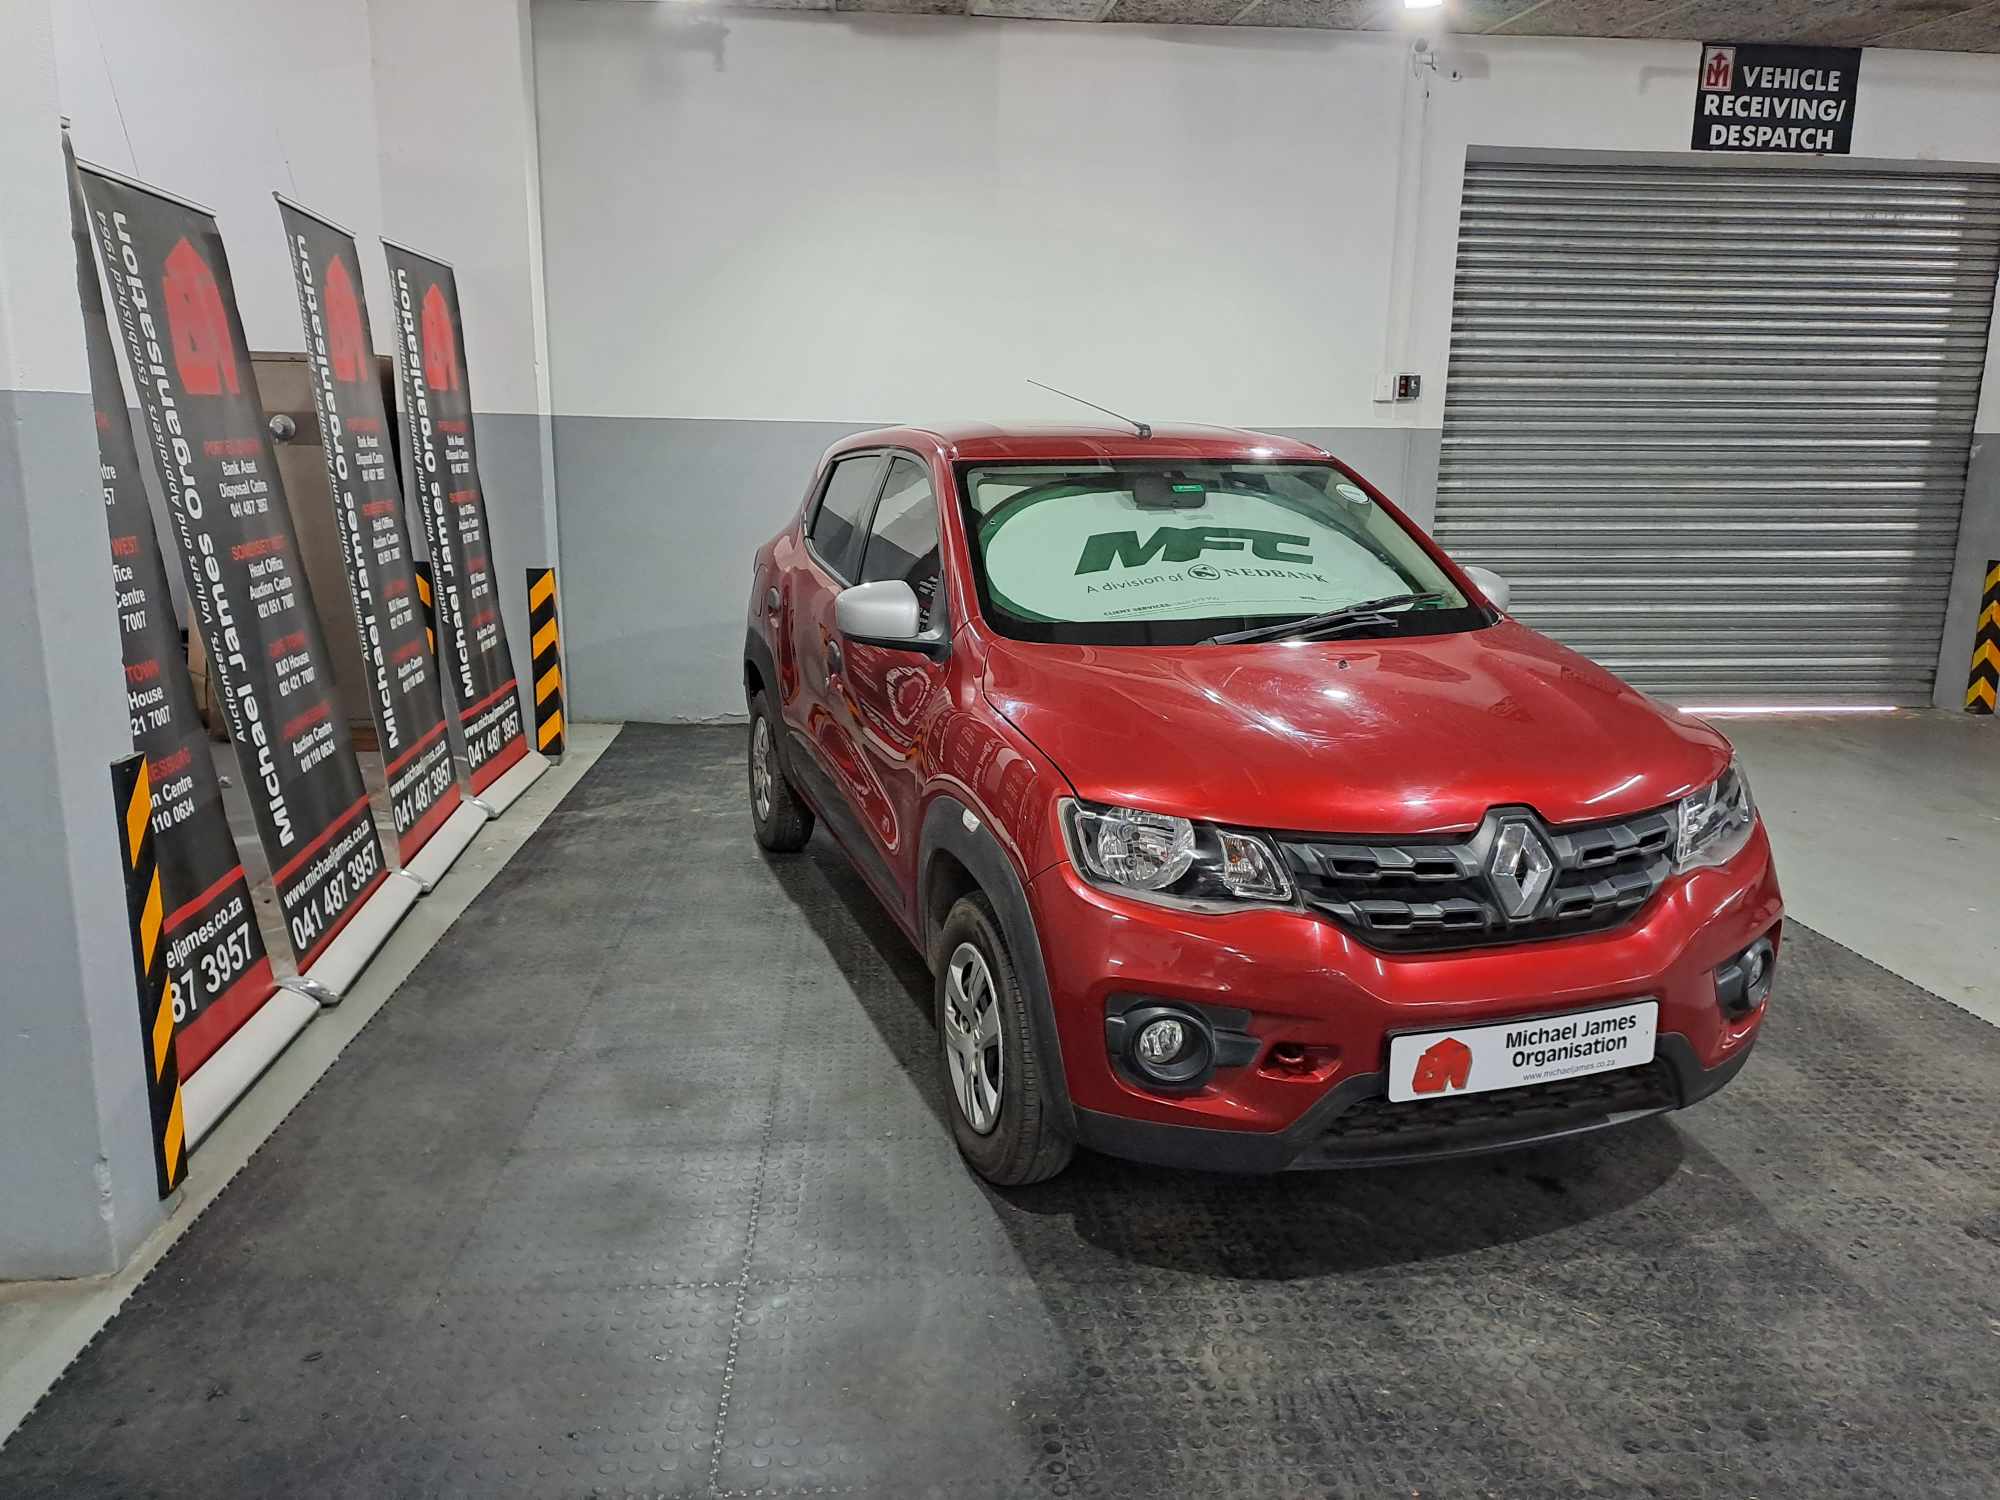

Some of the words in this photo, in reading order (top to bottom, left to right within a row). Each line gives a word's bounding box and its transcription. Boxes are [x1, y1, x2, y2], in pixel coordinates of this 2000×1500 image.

[1742, 66, 1841, 91] VEHICLE
[1703, 94, 1846, 122] RECEIVING/
[1709, 124, 1834, 150] DESPATCH
[96, 210, 118, 263] 1964
[109, 267, 149, 386] Established
[112, 211, 202, 519] Organisation
[297, 234, 348, 480] Organisation
[397, 268, 436, 473] Organisation
[148, 402, 182, 507] Appraisers
[415, 466, 427, 492] and
[174, 511, 193, 549] and
[421, 495, 435, 542] Valuers
[430, 481, 454, 577] James
[344, 491, 373, 606] James
[1074, 525, 1314, 576] MFC
[189, 555, 212, 623] Valuers
[198, 533, 246, 671] James
[1086, 585, 1099, 594] A
[1102, 574, 1165, 592] division
[1168, 572, 1184, 583] of
[1224, 568, 1330, 585] NEDBANK
[122, 610, 147, 633] 7007
[446, 585, 474, 698] Michael
[128, 686, 164, 711] House
[211, 632, 246, 742] Auctioneers,
[364, 614, 399, 749] Michael
[147, 705, 171, 729] 7007
[467, 736, 487, 768] 041
[487, 724, 501, 754] 487
[501, 710, 519, 742] 3957
[163, 775, 193, 802] Centre
[236, 684, 294, 847] Michael
[394, 793, 415, 833] 041
[415, 776, 432, 812] 487
[430, 756, 452, 796] 3957
[173, 797, 195, 823] 0634
[283, 819, 370, 909] www.michaeljames.co.za
[291, 898, 324, 950] 041
[323, 870, 349, 917] 487
[347, 839, 378, 891] 3957
[200, 921, 252, 993] 3957
[1505, 1023, 1577, 1049] Michael
[1581, 1014, 1637, 1038] James
[1511, 1035, 1628, 1068] Organisation
[1522, 1058, 1616, 1082] www.michaeljames.co.za
